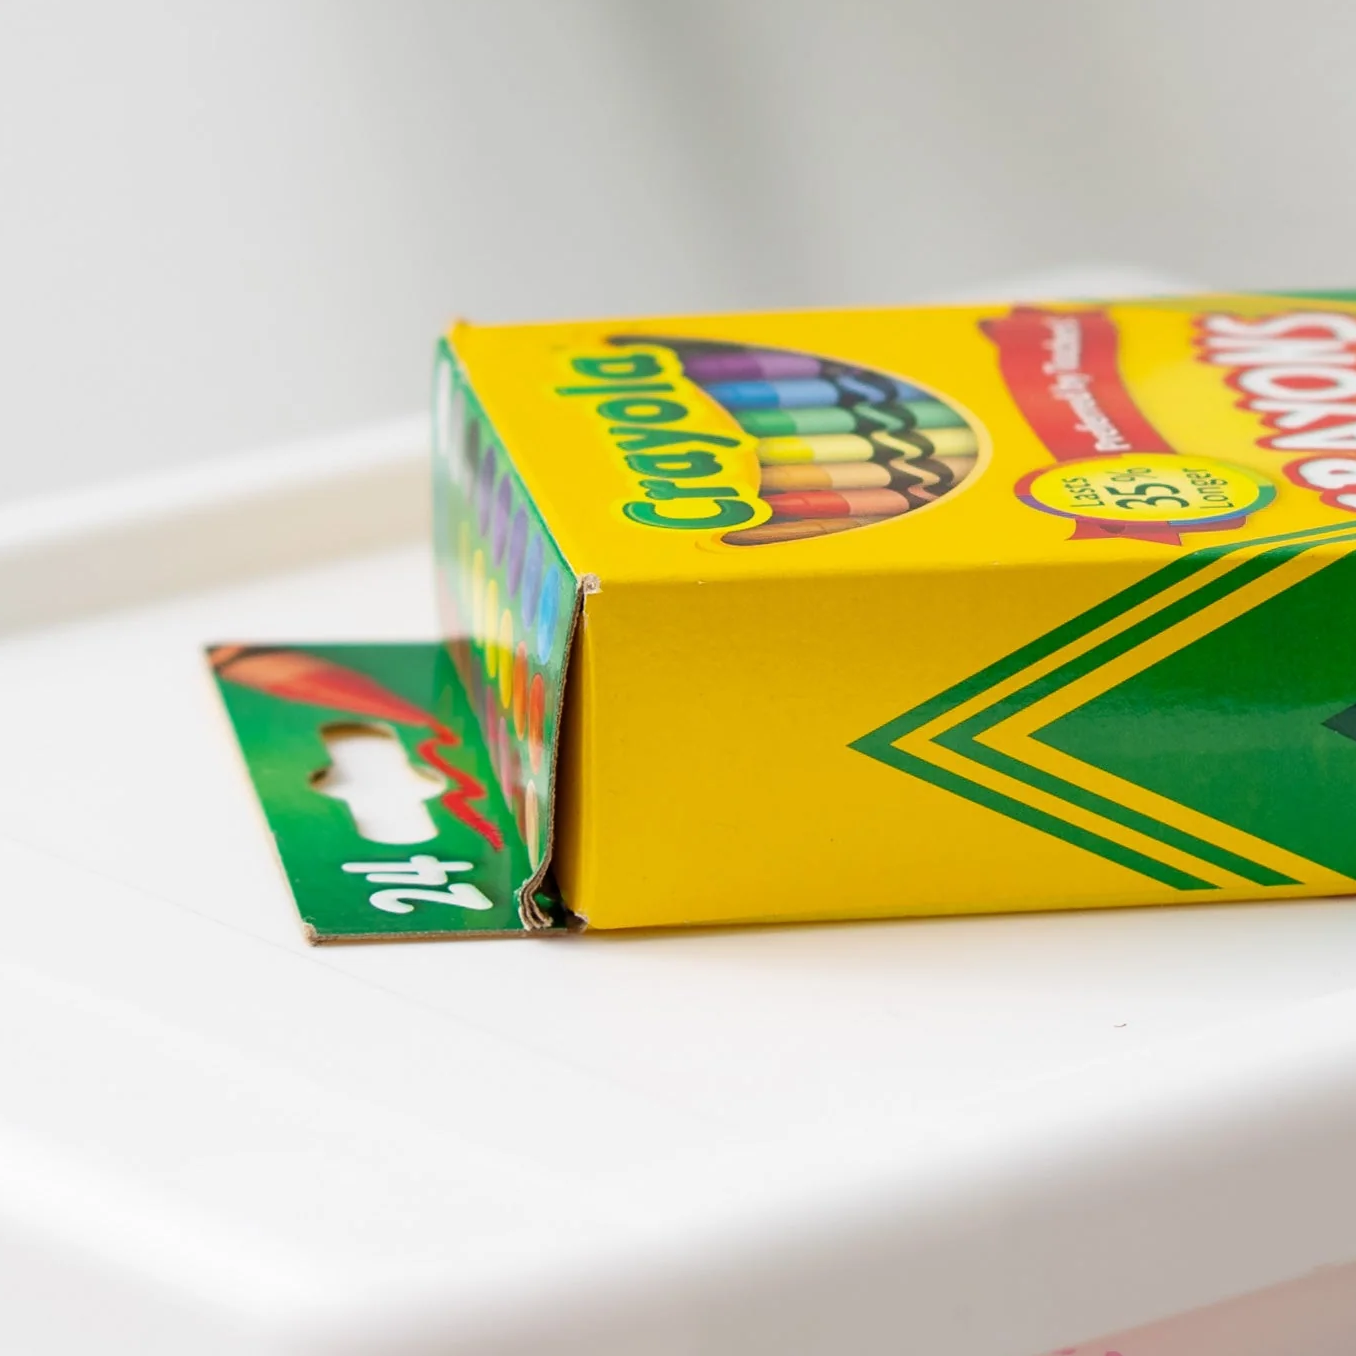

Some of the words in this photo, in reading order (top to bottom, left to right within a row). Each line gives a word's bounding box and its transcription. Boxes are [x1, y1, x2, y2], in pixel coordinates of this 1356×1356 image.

[555, 353, 756, 530] Crayola
[1062, 476, 1106, 508] Lasts
[1182, 467, 1234, 510] Longer
[341, 854, 494, 914] 24
